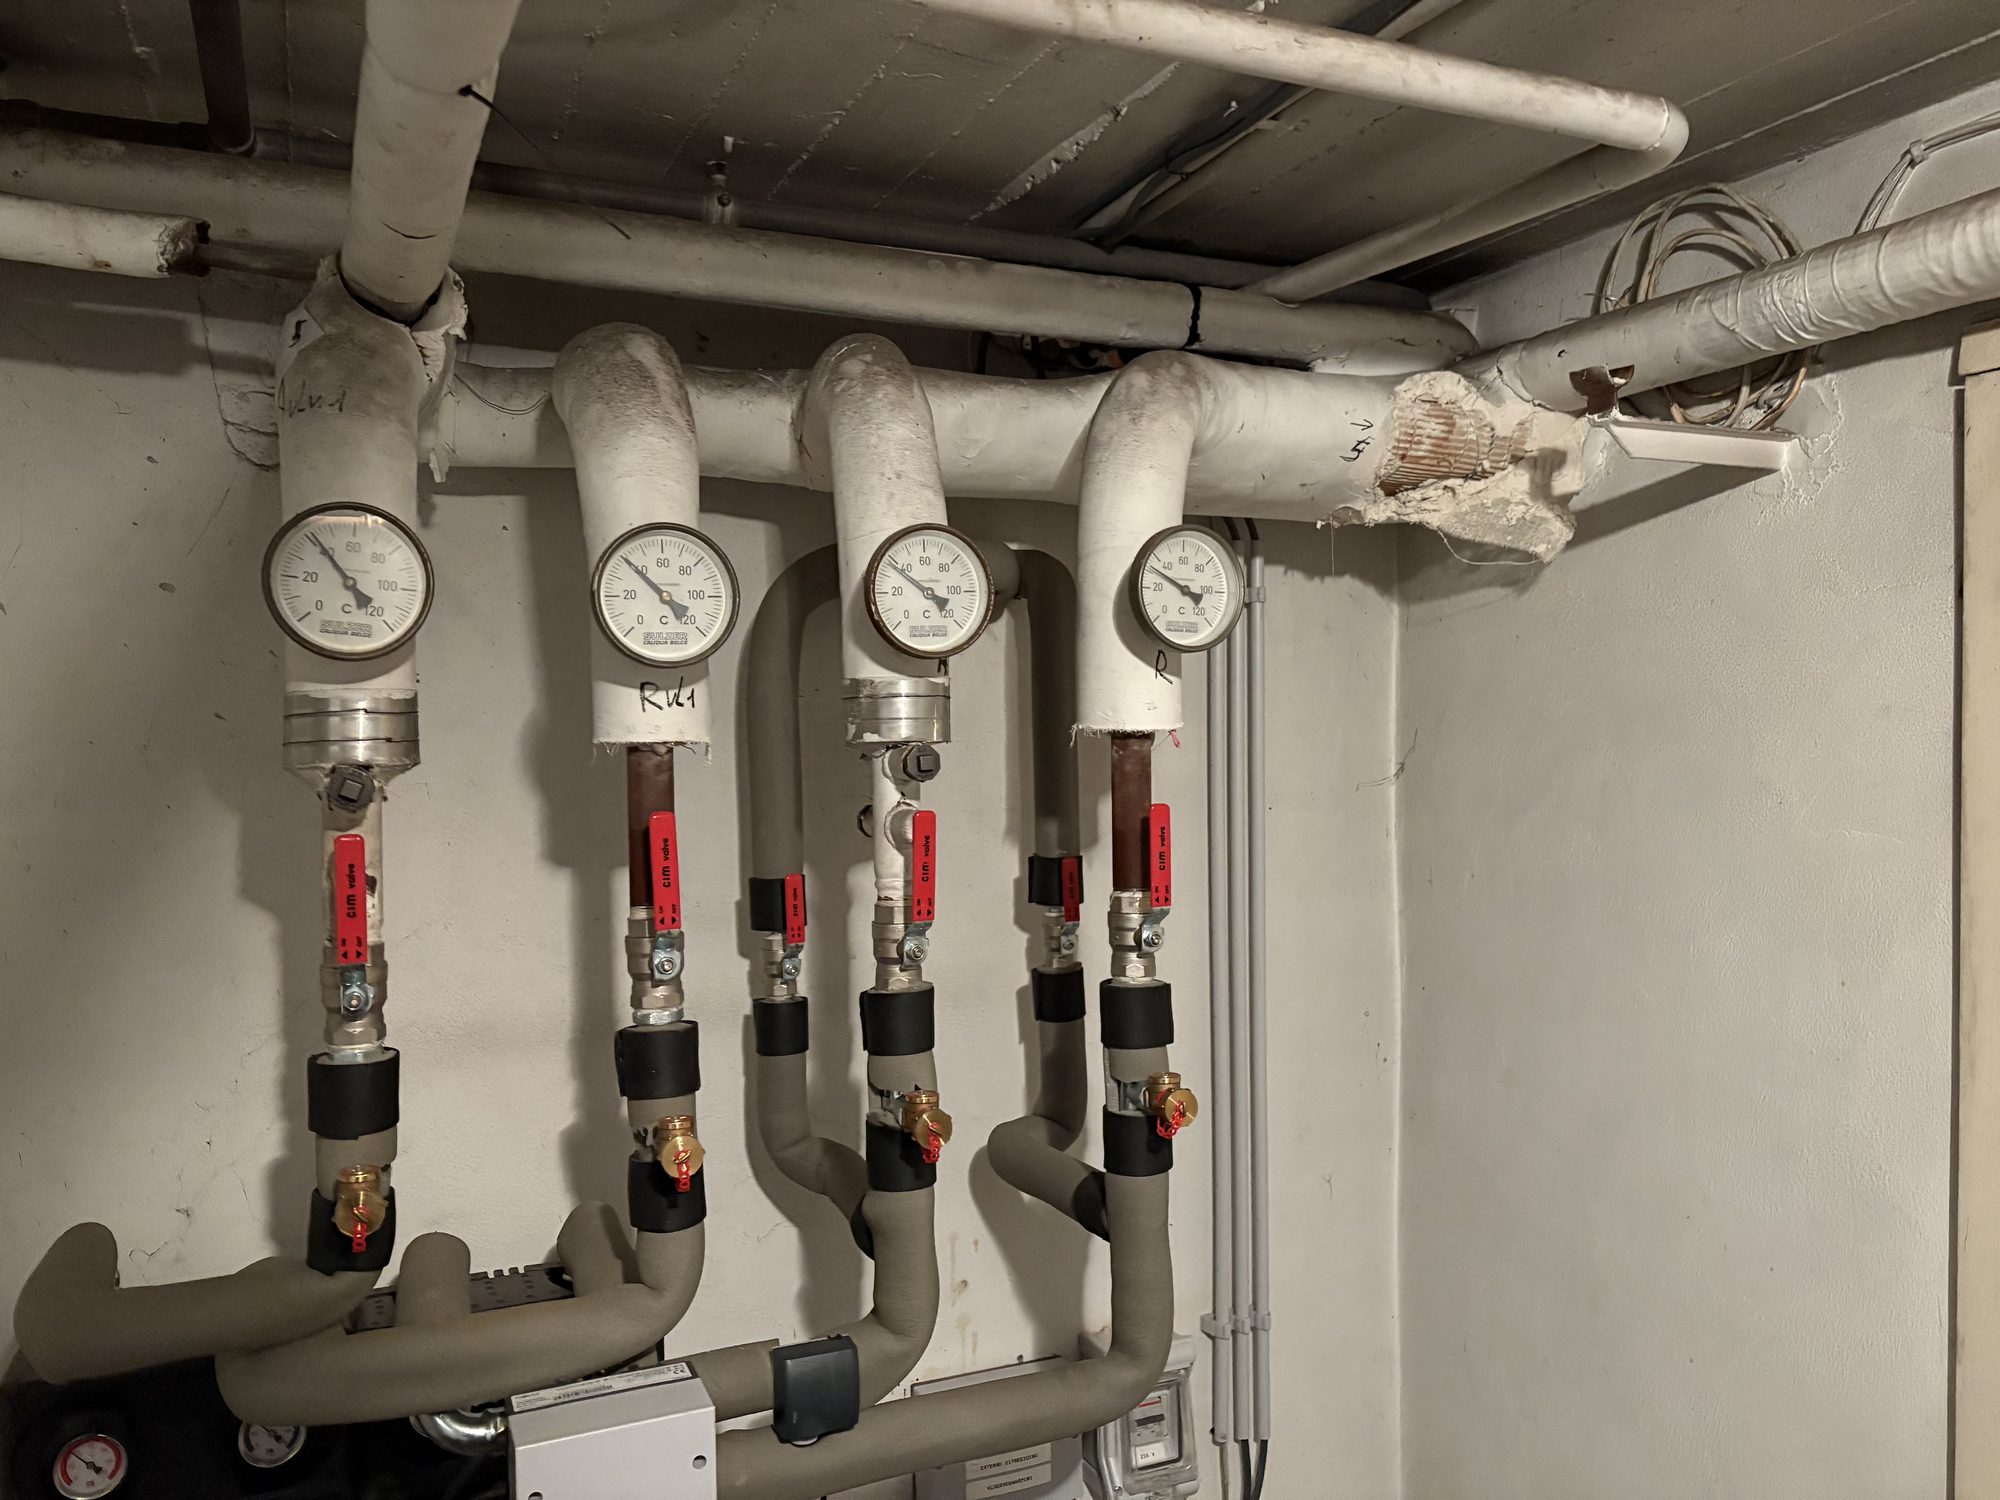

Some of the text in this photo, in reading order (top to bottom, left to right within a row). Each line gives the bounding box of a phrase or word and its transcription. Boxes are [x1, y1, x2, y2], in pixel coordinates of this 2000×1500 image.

[345, 541, 361, 553] 60
[371, 552, 386, 564] 80
[656, 558, 669, 568] 60
[919, 557, 930, 566] 60
[1178, 556, 1188, 565] 60
[679, 565, 692, 575] 80
[939, 563, 950, 572] 80
[1195, 564, 1205, 573] 80
[302, 571, 319, 583] 20
[378, 580, 398, 592] 100
[946, 585, 961, 595] 100
[1153, 582, 1163, 592] 20
[1200, 585, 1213, 595] 100
[623, 590, 636, 600] 20
[687, 590, 705, 600] 100
[891, 587, 903, 596] 20
[315, 600, 323, 611] 0
[342, 604, 352, 614] C
[1162, 605, 1167, 614] 0
[365, 605, 384, 617] 120
[904, 610, 909, 619] 0
[923, 610, 930, 619] C
[940, 609, 954, 618] 120
[1178, 607, 1185, 615] C
[1193, 607, 1205, 616] 120
[637, 615, 643, 625] 0
[659, 615, 669, 625] C
[680, 615, 696, 625] 120
[643, 632, 688, 641] SULZER
[1155, 649, 1173, 685] R
[922, 835, 930, 857] valve
[662, 866, 671, 888] cim
[346, 863, 356, 919] cim valve
